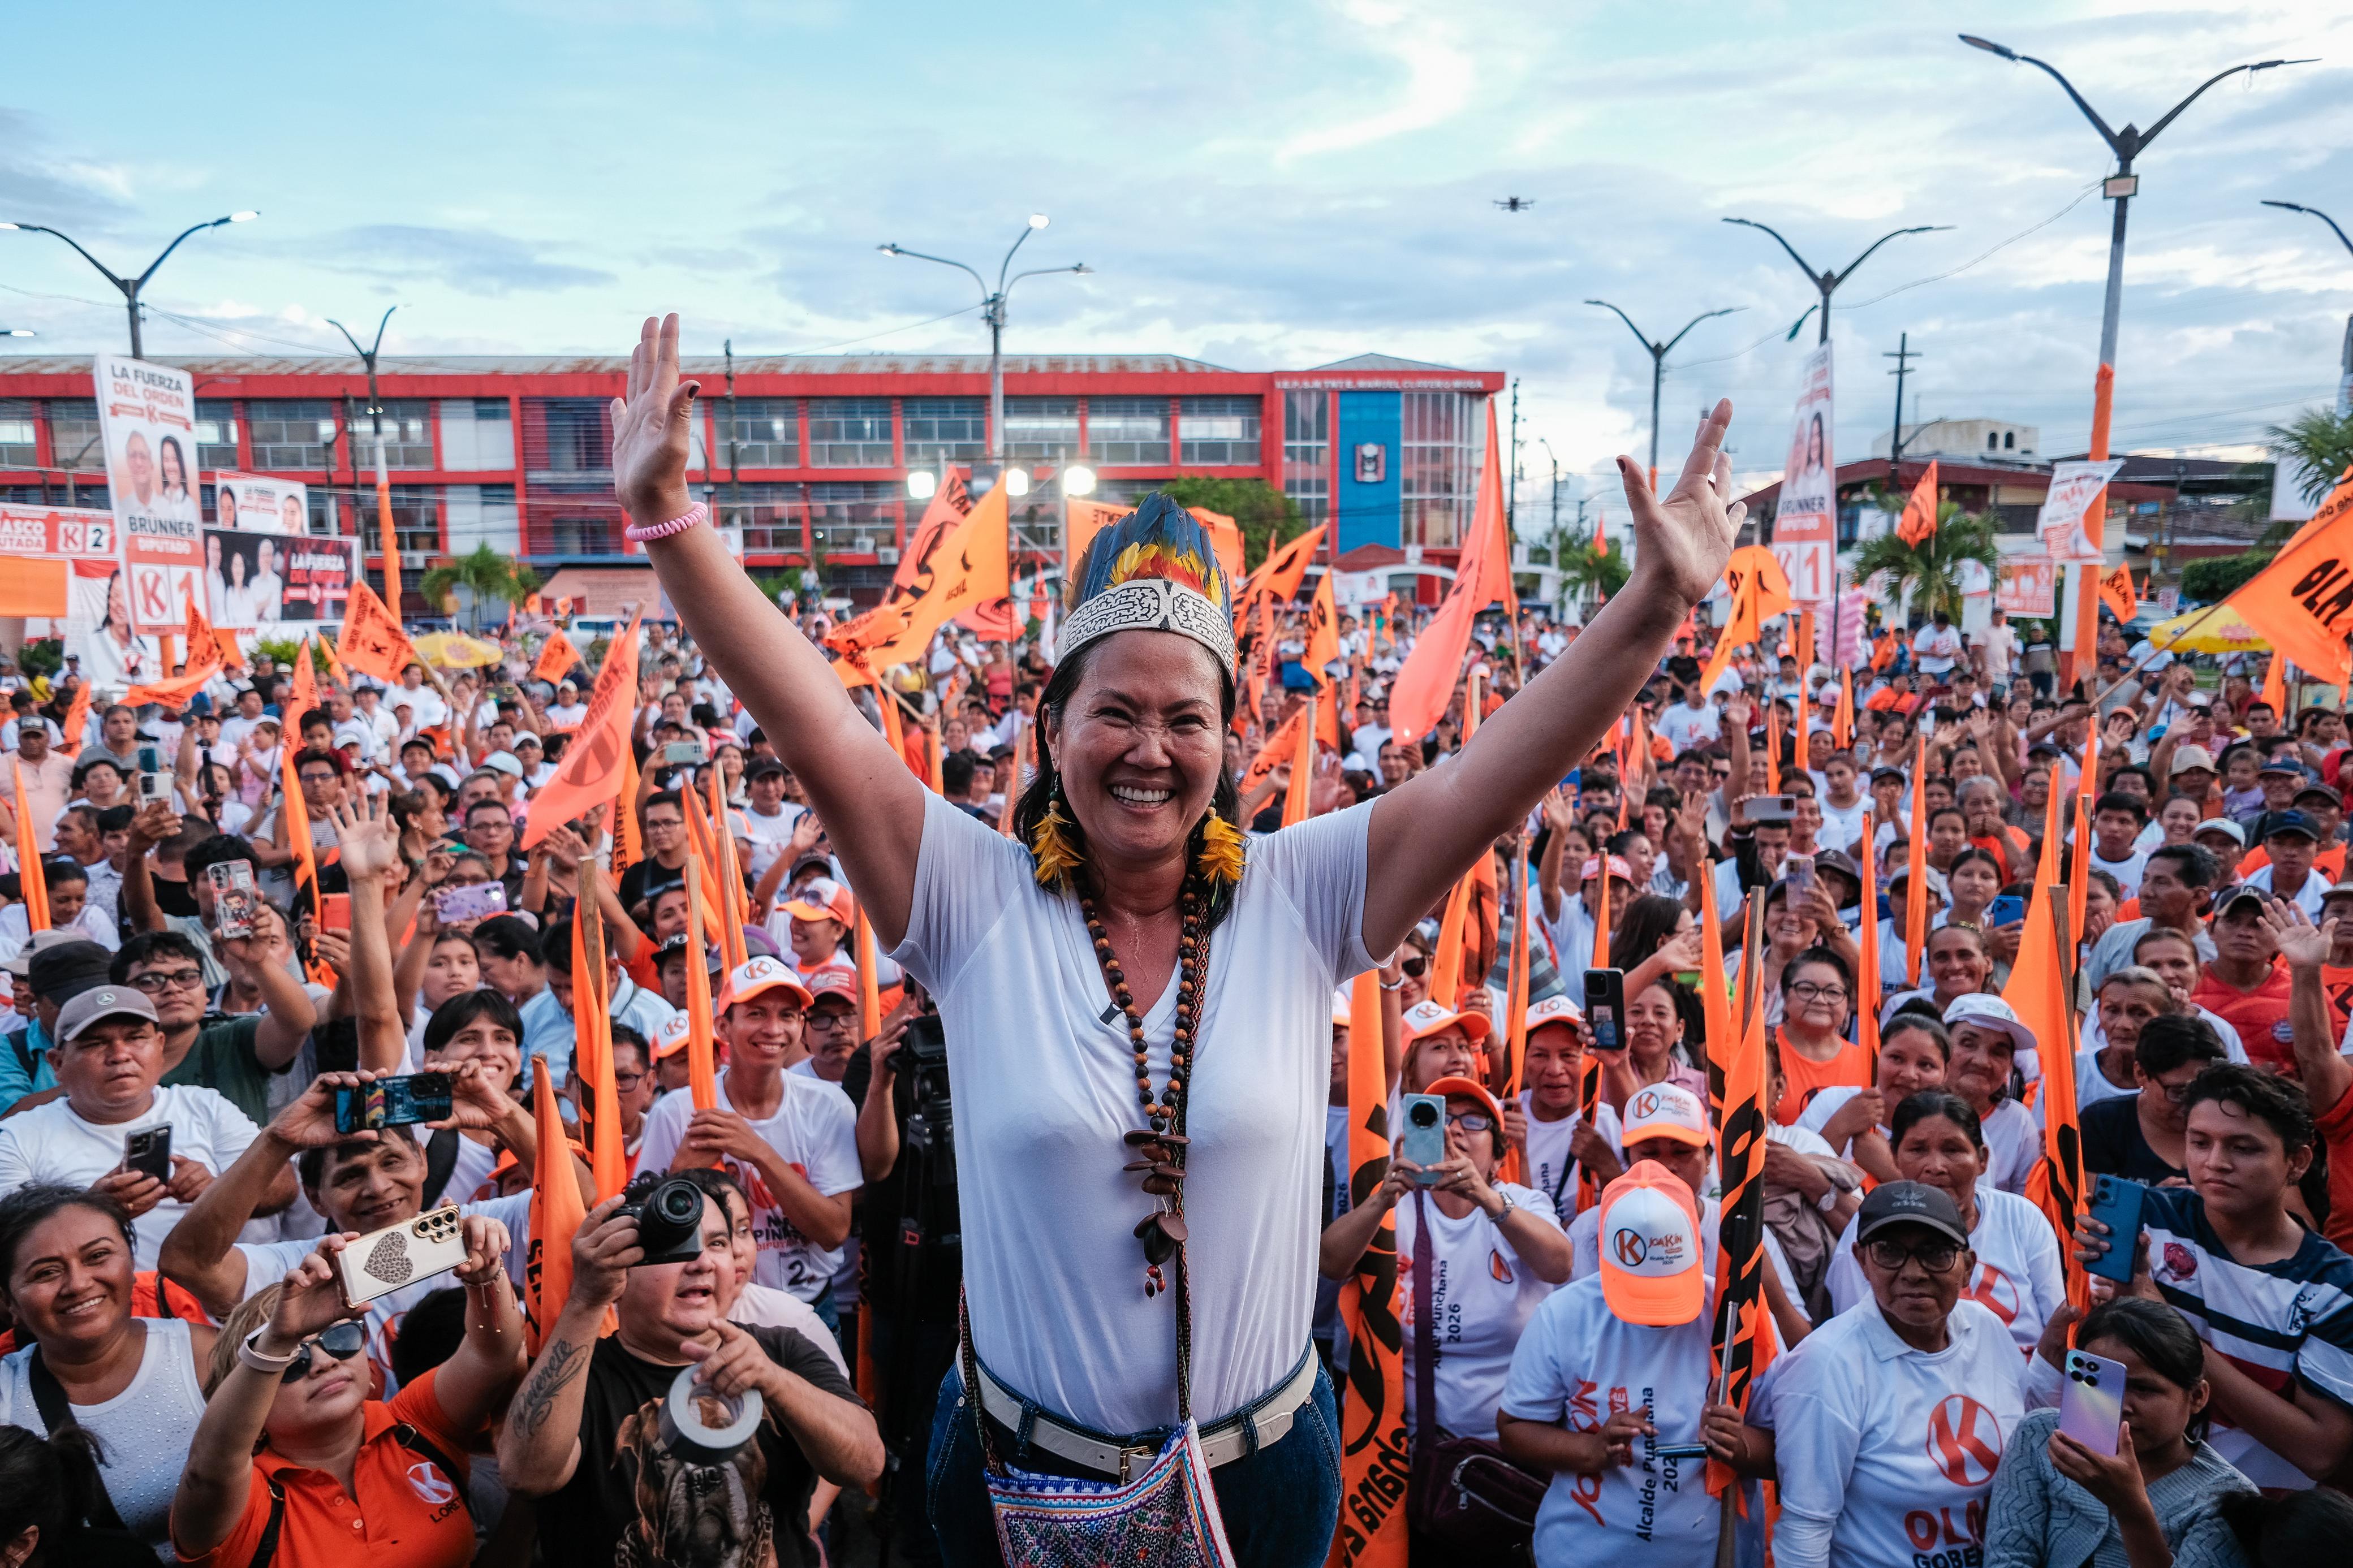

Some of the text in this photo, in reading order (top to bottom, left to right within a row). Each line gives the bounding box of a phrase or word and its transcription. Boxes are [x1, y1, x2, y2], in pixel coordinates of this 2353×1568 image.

[111, 363, 183, 391] LA FUERZA
[113, 382, 184, 408] DEL ORDEN
[0, 518, 46, 535] ASCO
[92, 528, 103, 547] 2
[1804, 546, 1821, 595] 1
[138, 571, 168, 619] K
[1615, 1229, 1645, 1266] K
[788, 1259, 805, 1286] 2
[1446, 1302, 1462, 1343] 2026
[1927, 1394, 2003, 1487] K
[407, 1462, 453, 1503] K
[1662, 1454, 1678, 1492] 202
[1636, 1477, 1657, 1543] Alcalde
